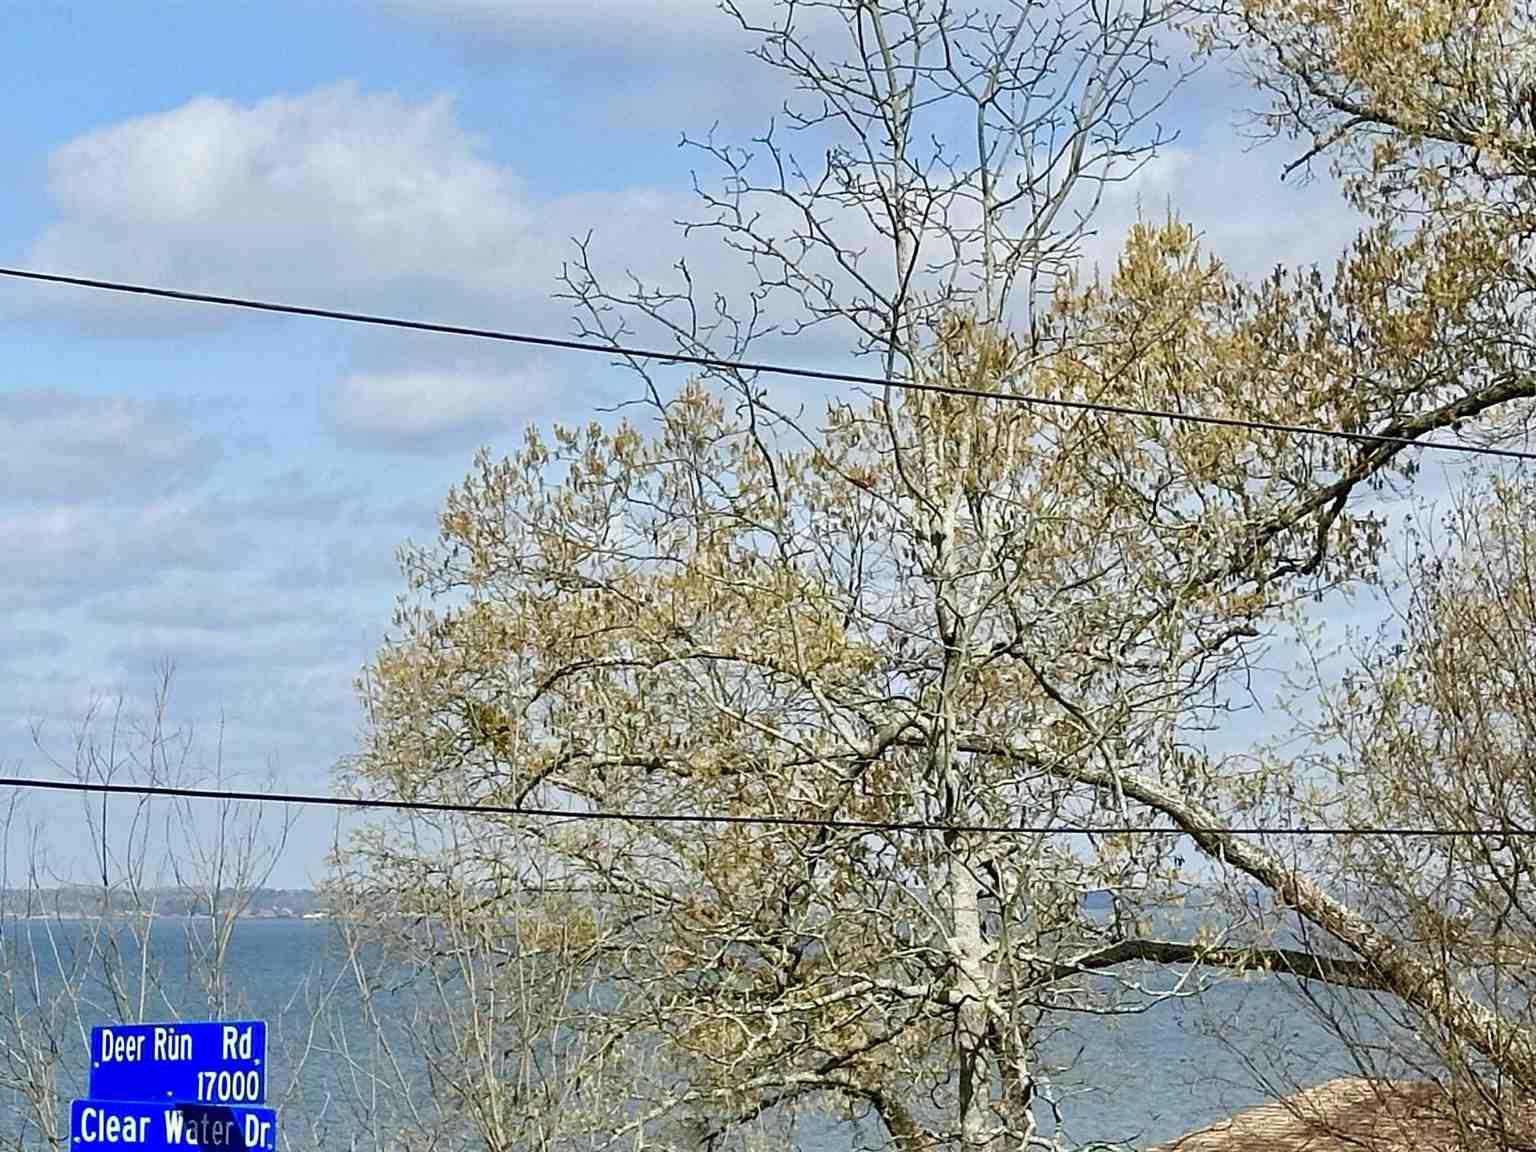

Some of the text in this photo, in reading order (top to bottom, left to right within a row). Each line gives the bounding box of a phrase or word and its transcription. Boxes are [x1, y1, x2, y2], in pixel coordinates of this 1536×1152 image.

[101, 1026, 252, 1062] Deer Run Rd
[197, 1070, 260, 1101] 17000
[80, 1107, 271, 1148] Clear Water Dr
